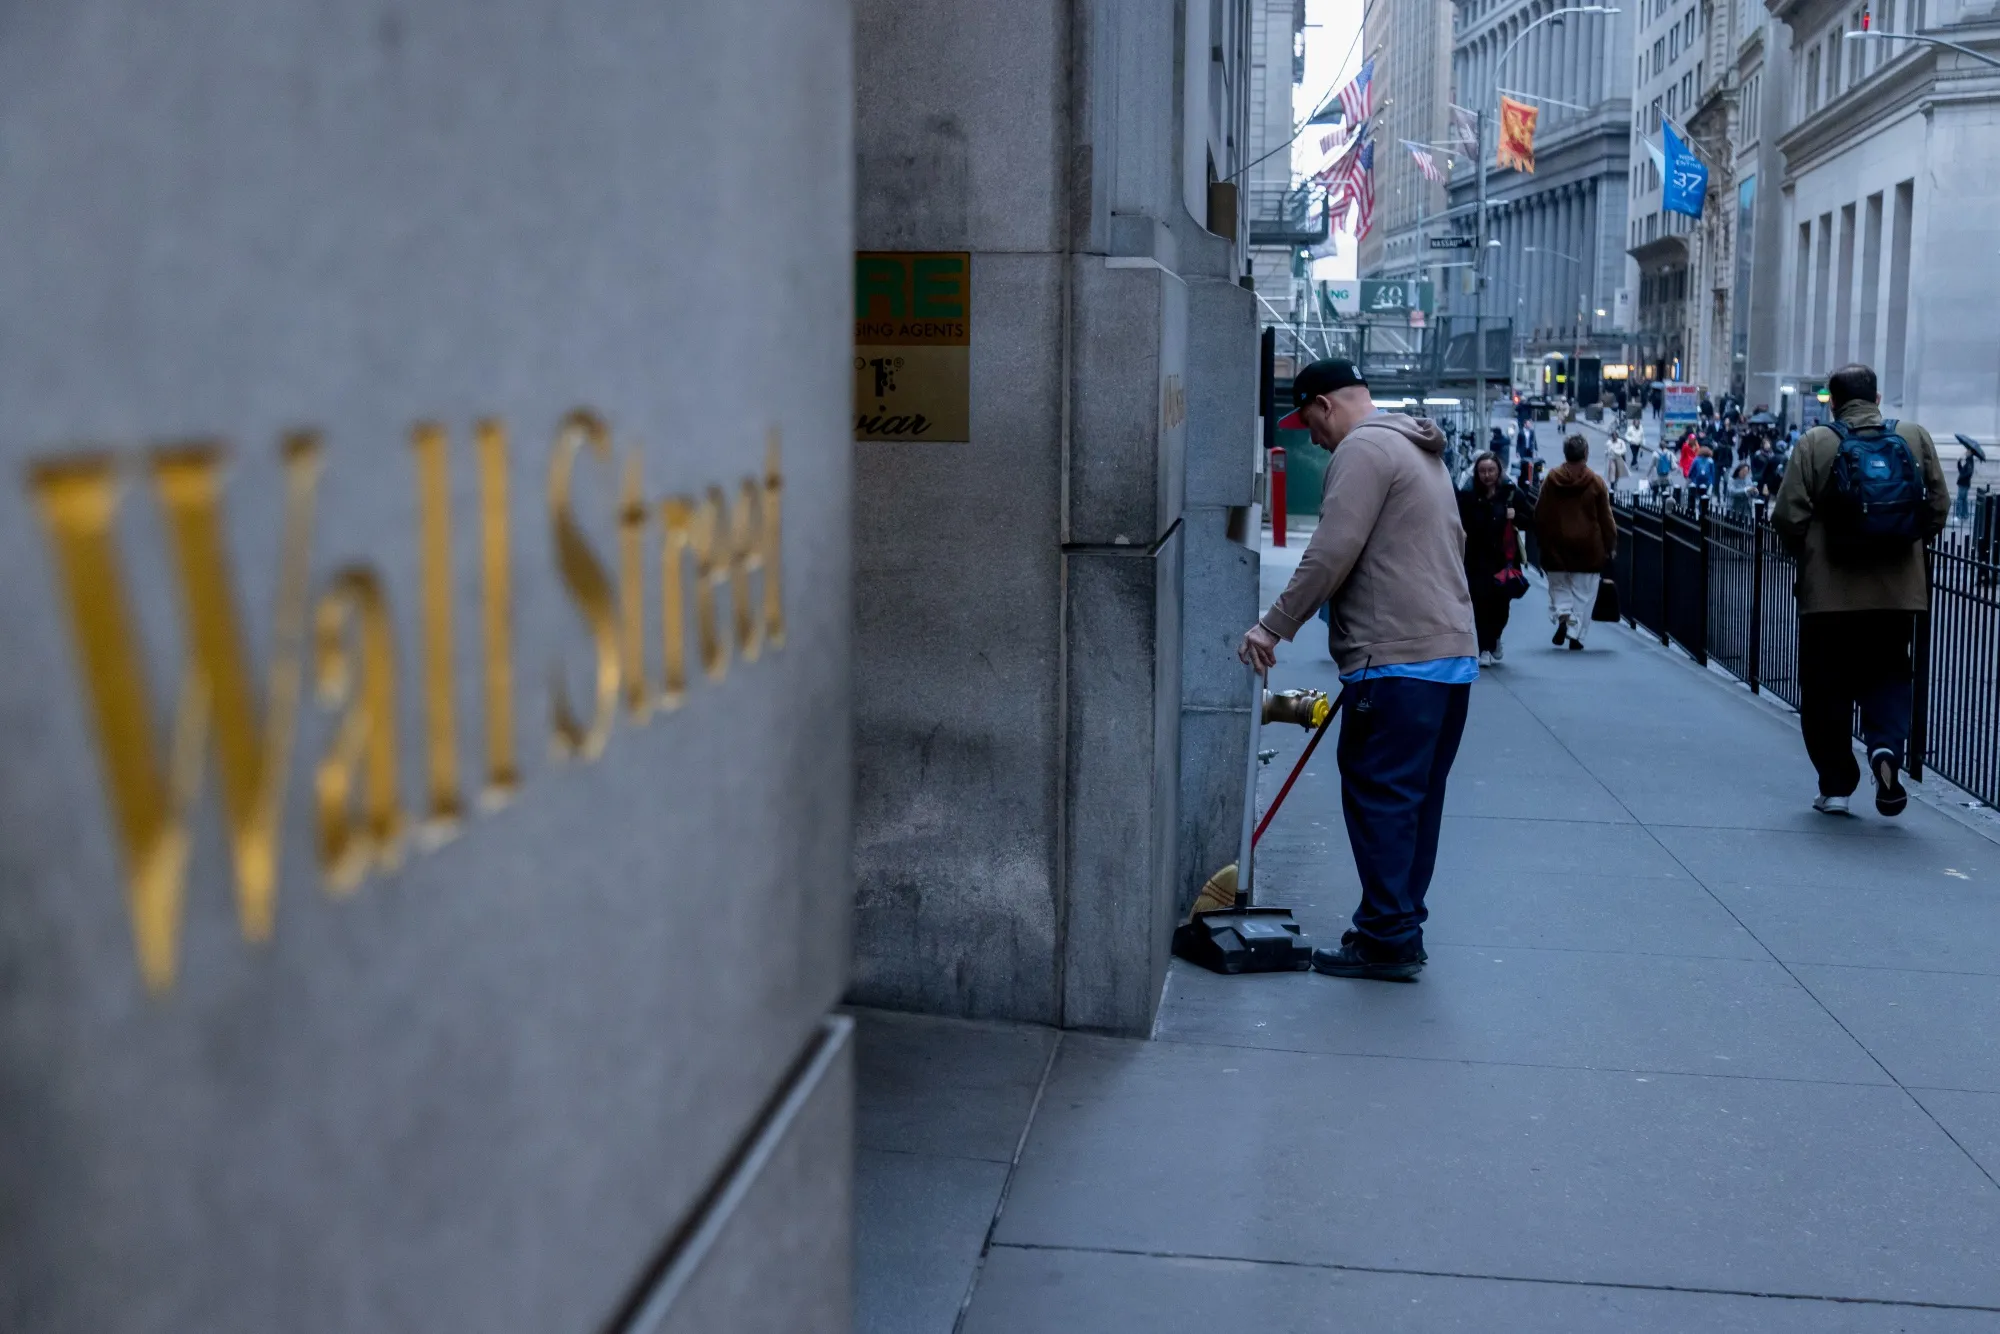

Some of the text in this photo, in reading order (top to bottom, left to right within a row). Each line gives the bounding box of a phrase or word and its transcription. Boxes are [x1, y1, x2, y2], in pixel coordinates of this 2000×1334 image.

[1431, 239, 1457, 248] NASSAU
[899, 322, 963, 337] AGENTS
[28, 408, 786, 992] Wall Street
